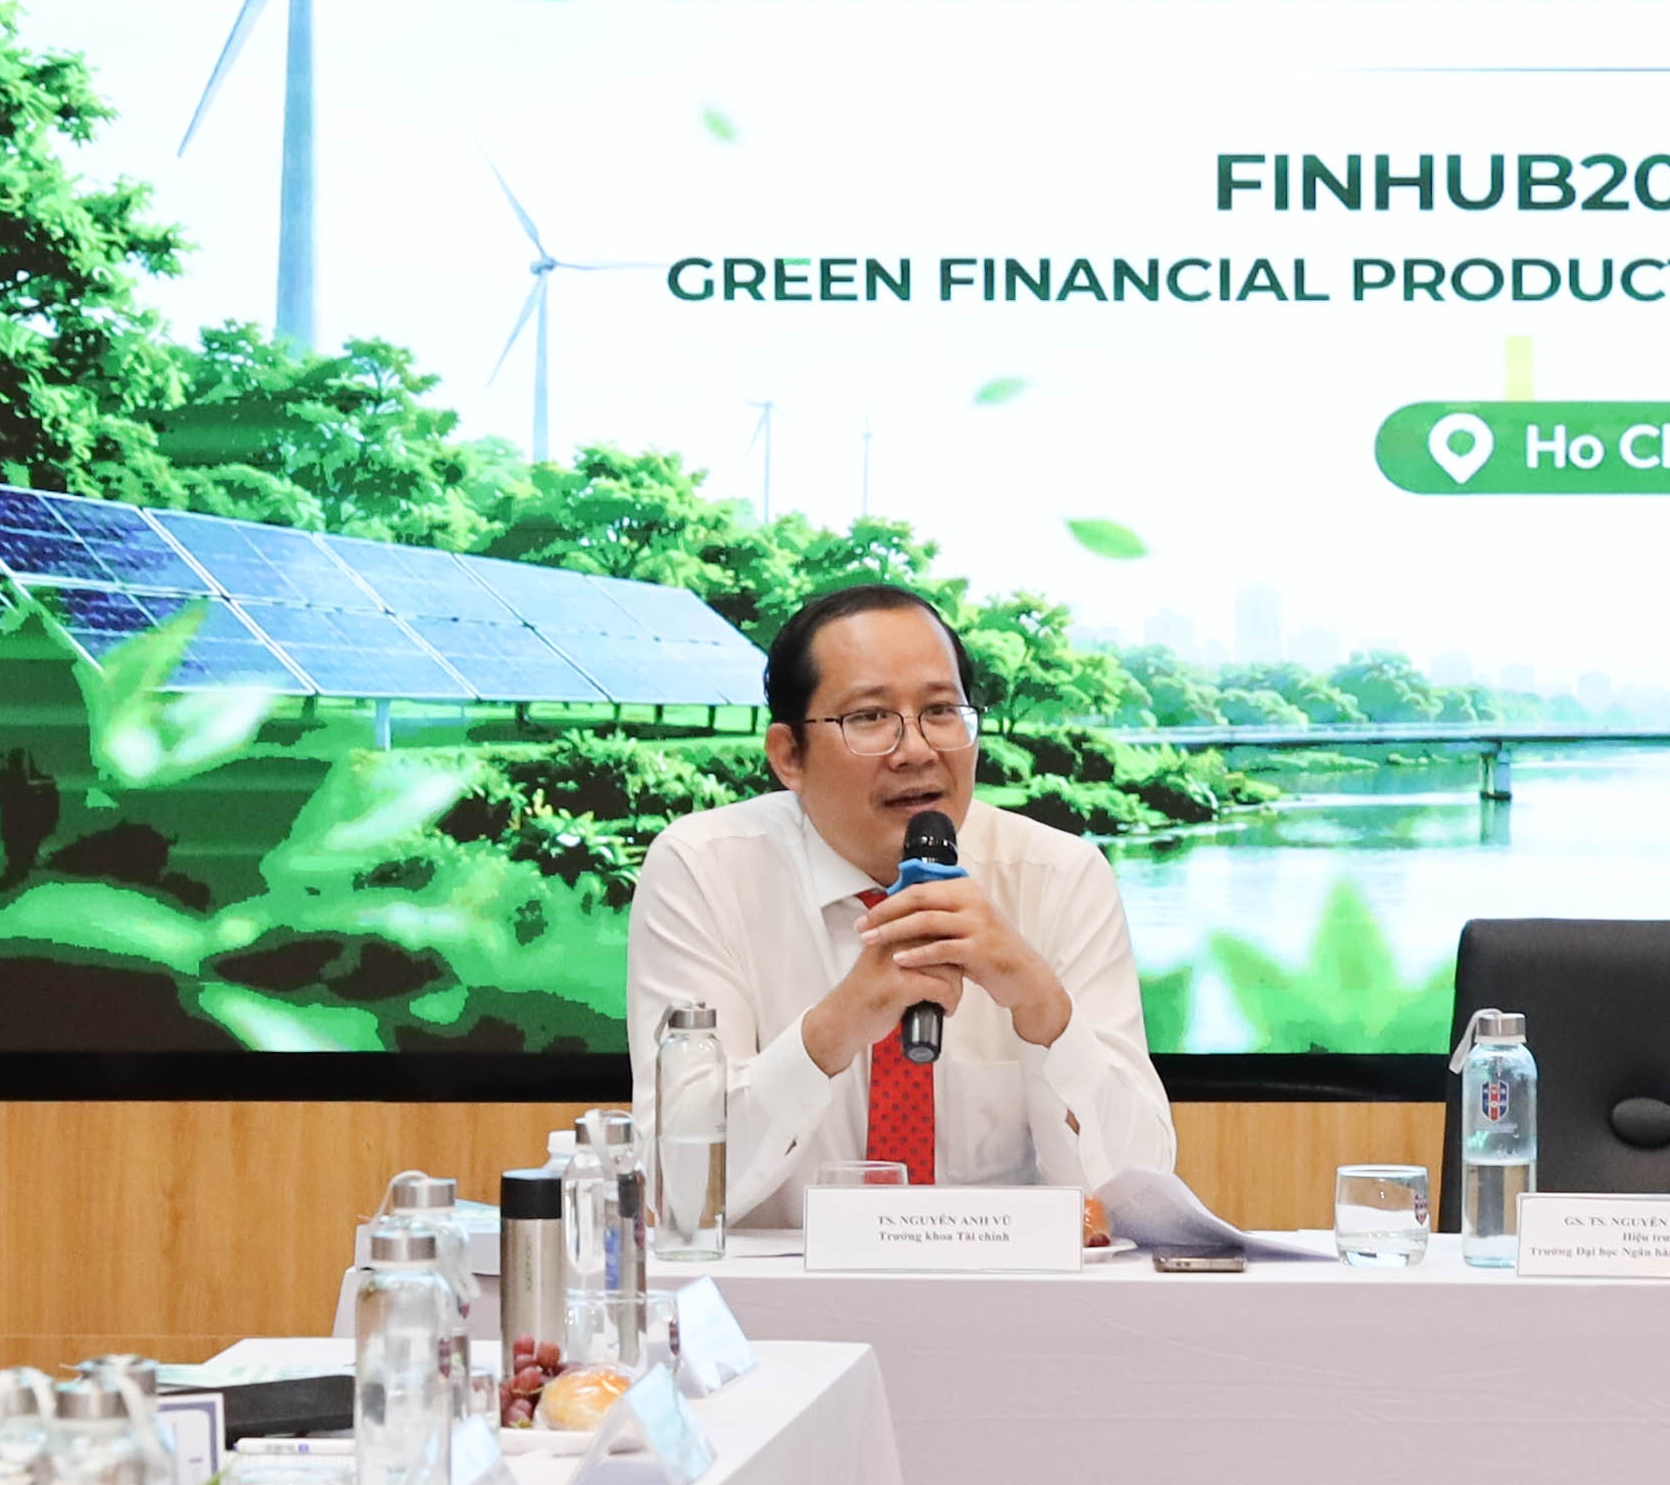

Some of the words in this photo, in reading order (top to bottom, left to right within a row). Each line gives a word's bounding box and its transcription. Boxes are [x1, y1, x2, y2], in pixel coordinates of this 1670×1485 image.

[667, 257, 911, 301] GREEN
[940, 258, 1330, 302] FINANCIAL
[1528, 425, 1603, 468] Ho
[960, 1215, 989, 1226] ANH
[925, 1231, 952, 1242] khoa
